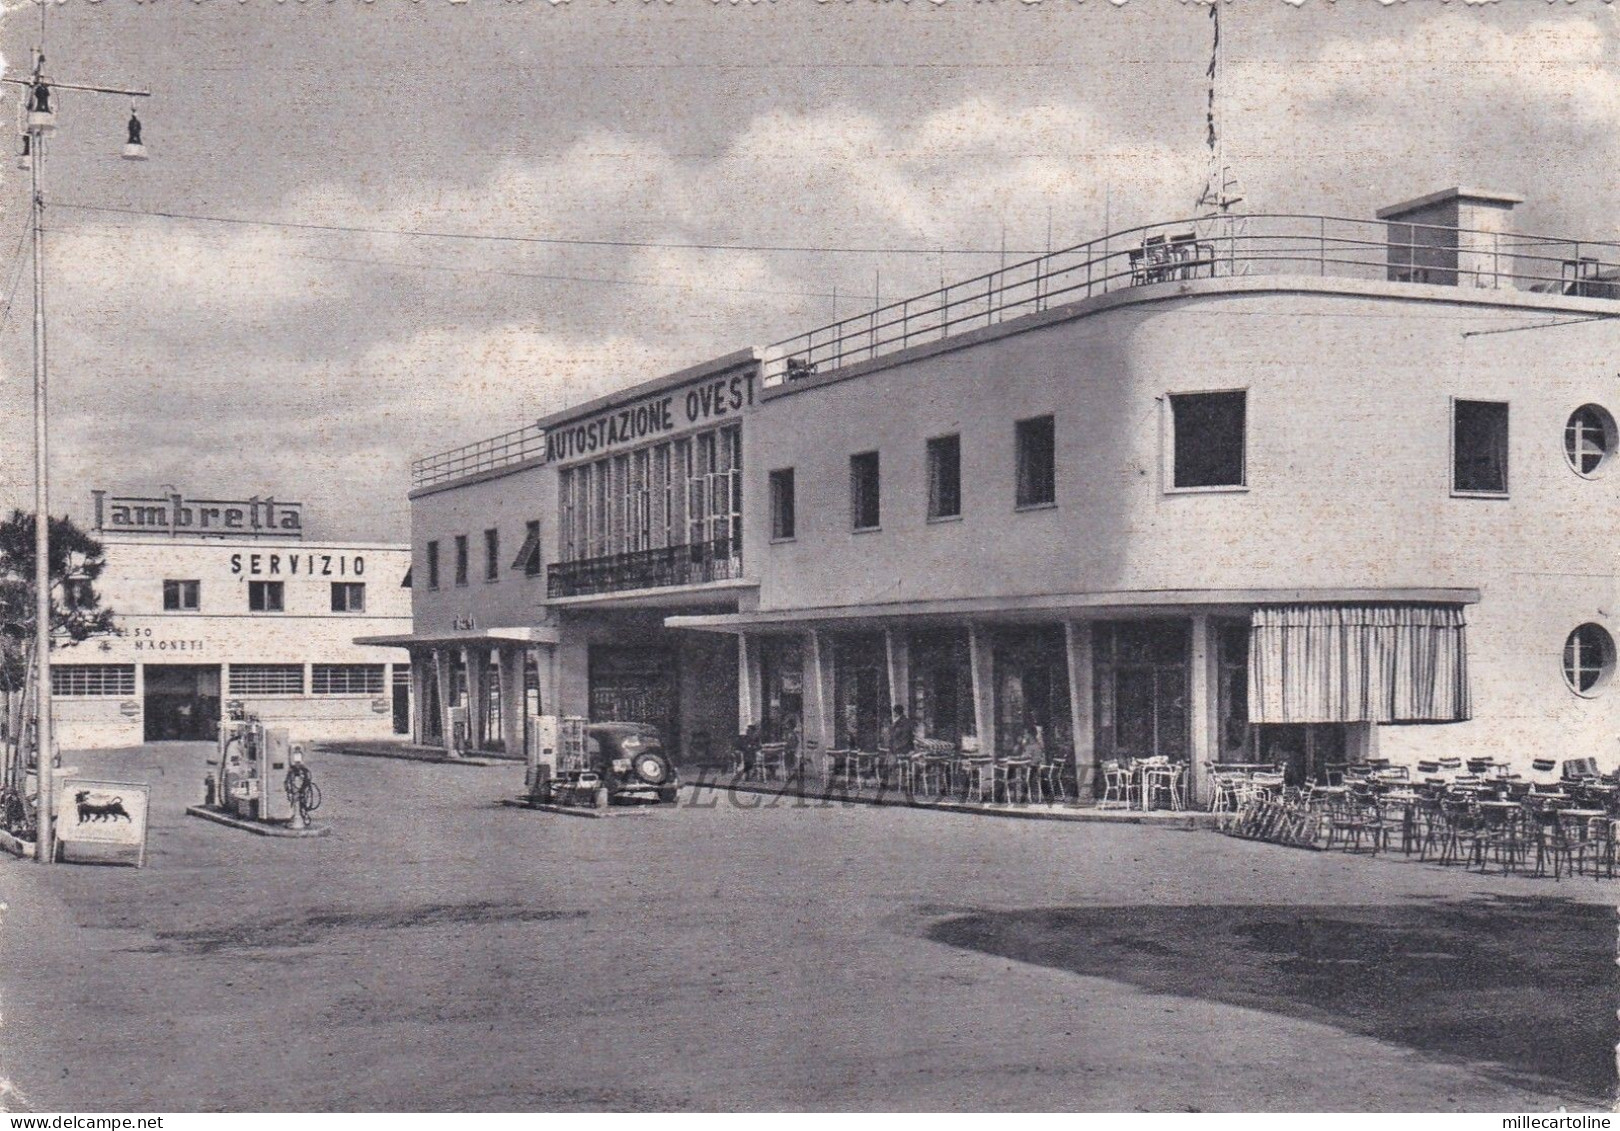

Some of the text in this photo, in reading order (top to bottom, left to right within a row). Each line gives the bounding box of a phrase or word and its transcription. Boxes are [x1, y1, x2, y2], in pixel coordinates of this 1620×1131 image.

[546, 371, 758, 462] AUTOSTAZIONE OVEST
[230, 553, 365, 576] SERVIZIO
